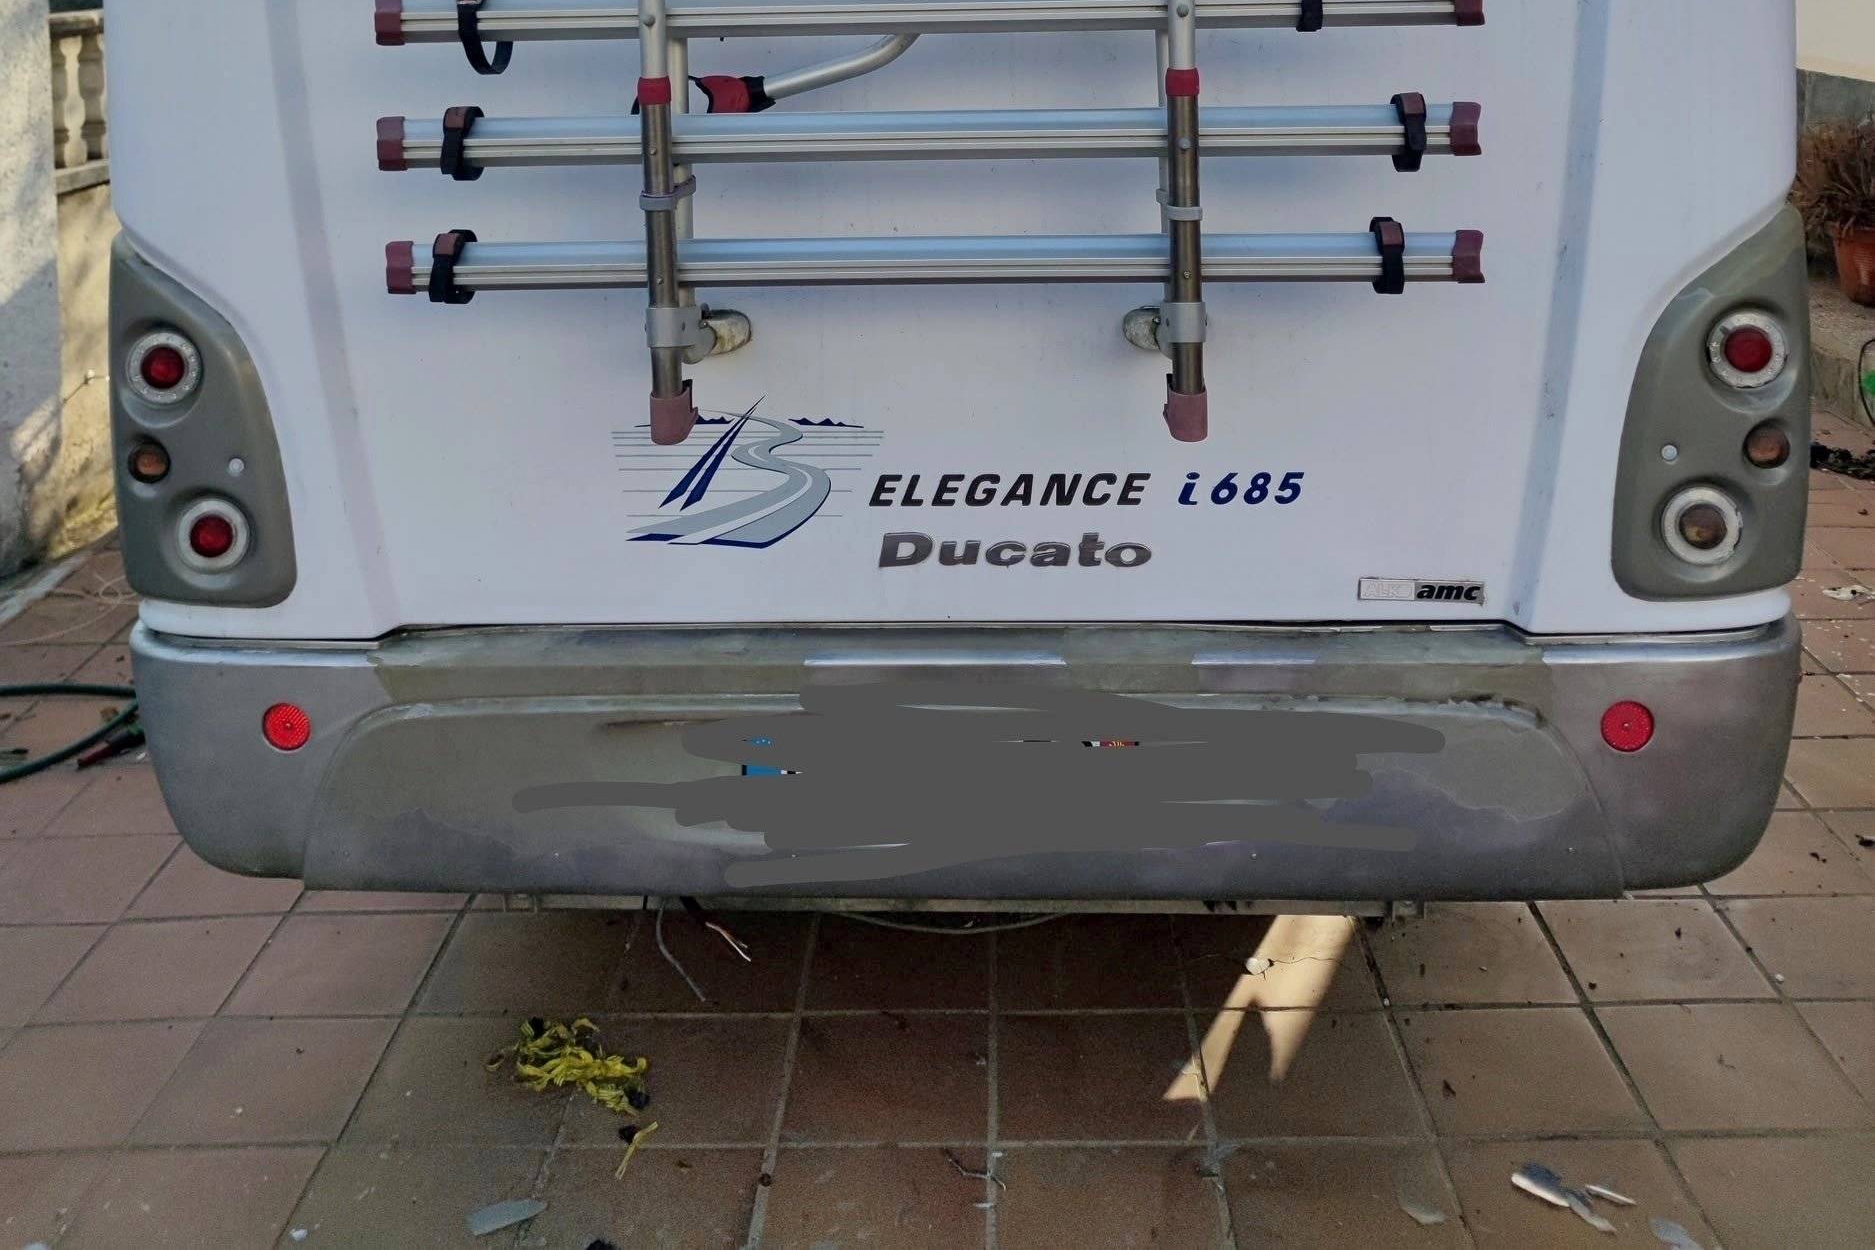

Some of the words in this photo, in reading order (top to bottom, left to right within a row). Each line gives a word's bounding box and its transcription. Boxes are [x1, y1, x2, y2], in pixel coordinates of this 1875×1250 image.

[869, 473, 1152, 506] ELEGANCE
[879, 531, 1153, 568] Ducato
[1417, 584, 1482, 601] amc
